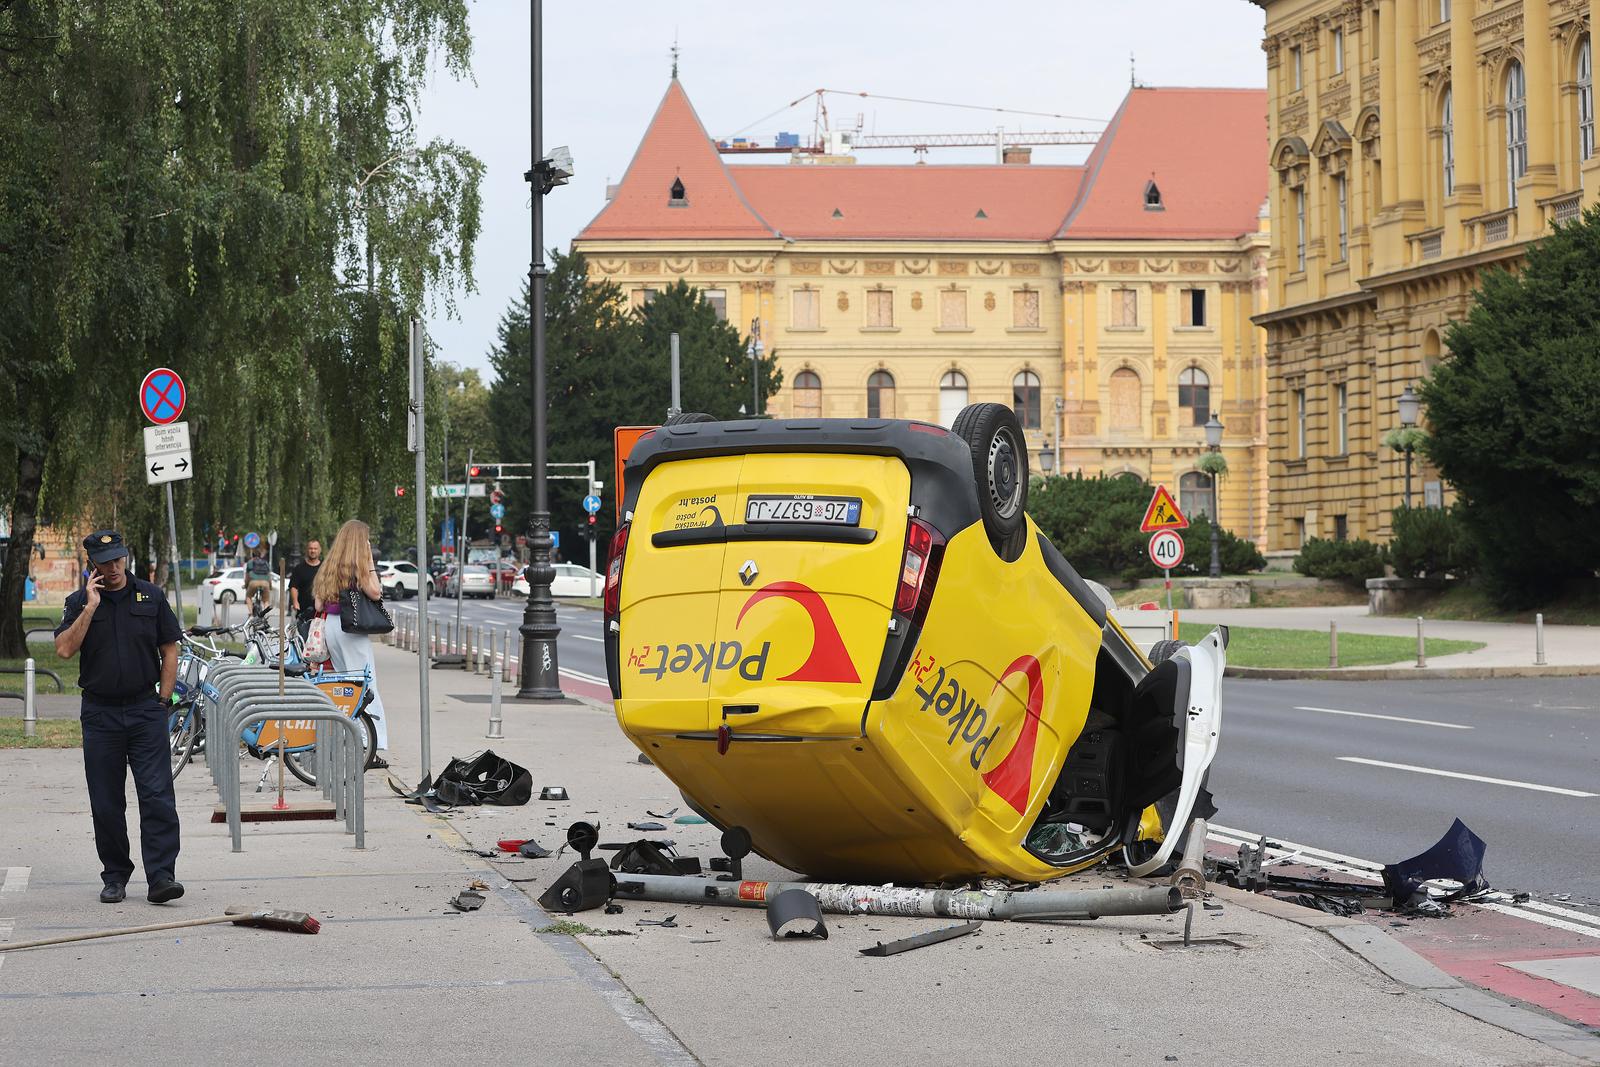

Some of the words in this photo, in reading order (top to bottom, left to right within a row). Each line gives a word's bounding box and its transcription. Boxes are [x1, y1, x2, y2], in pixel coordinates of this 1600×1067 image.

[678, 494, 717, 507] posta.hr
[824, 503, 846, 520] ZG
[674, 520, 708, 530] Hrvatska
[1157, 540, 1176, 558] 40
[627, 645, 650, 668] 24
[639, 641, 771, 683] Paket
[908, 649, 935, 684] 24
[914, 666, 1001, 771] Paket
